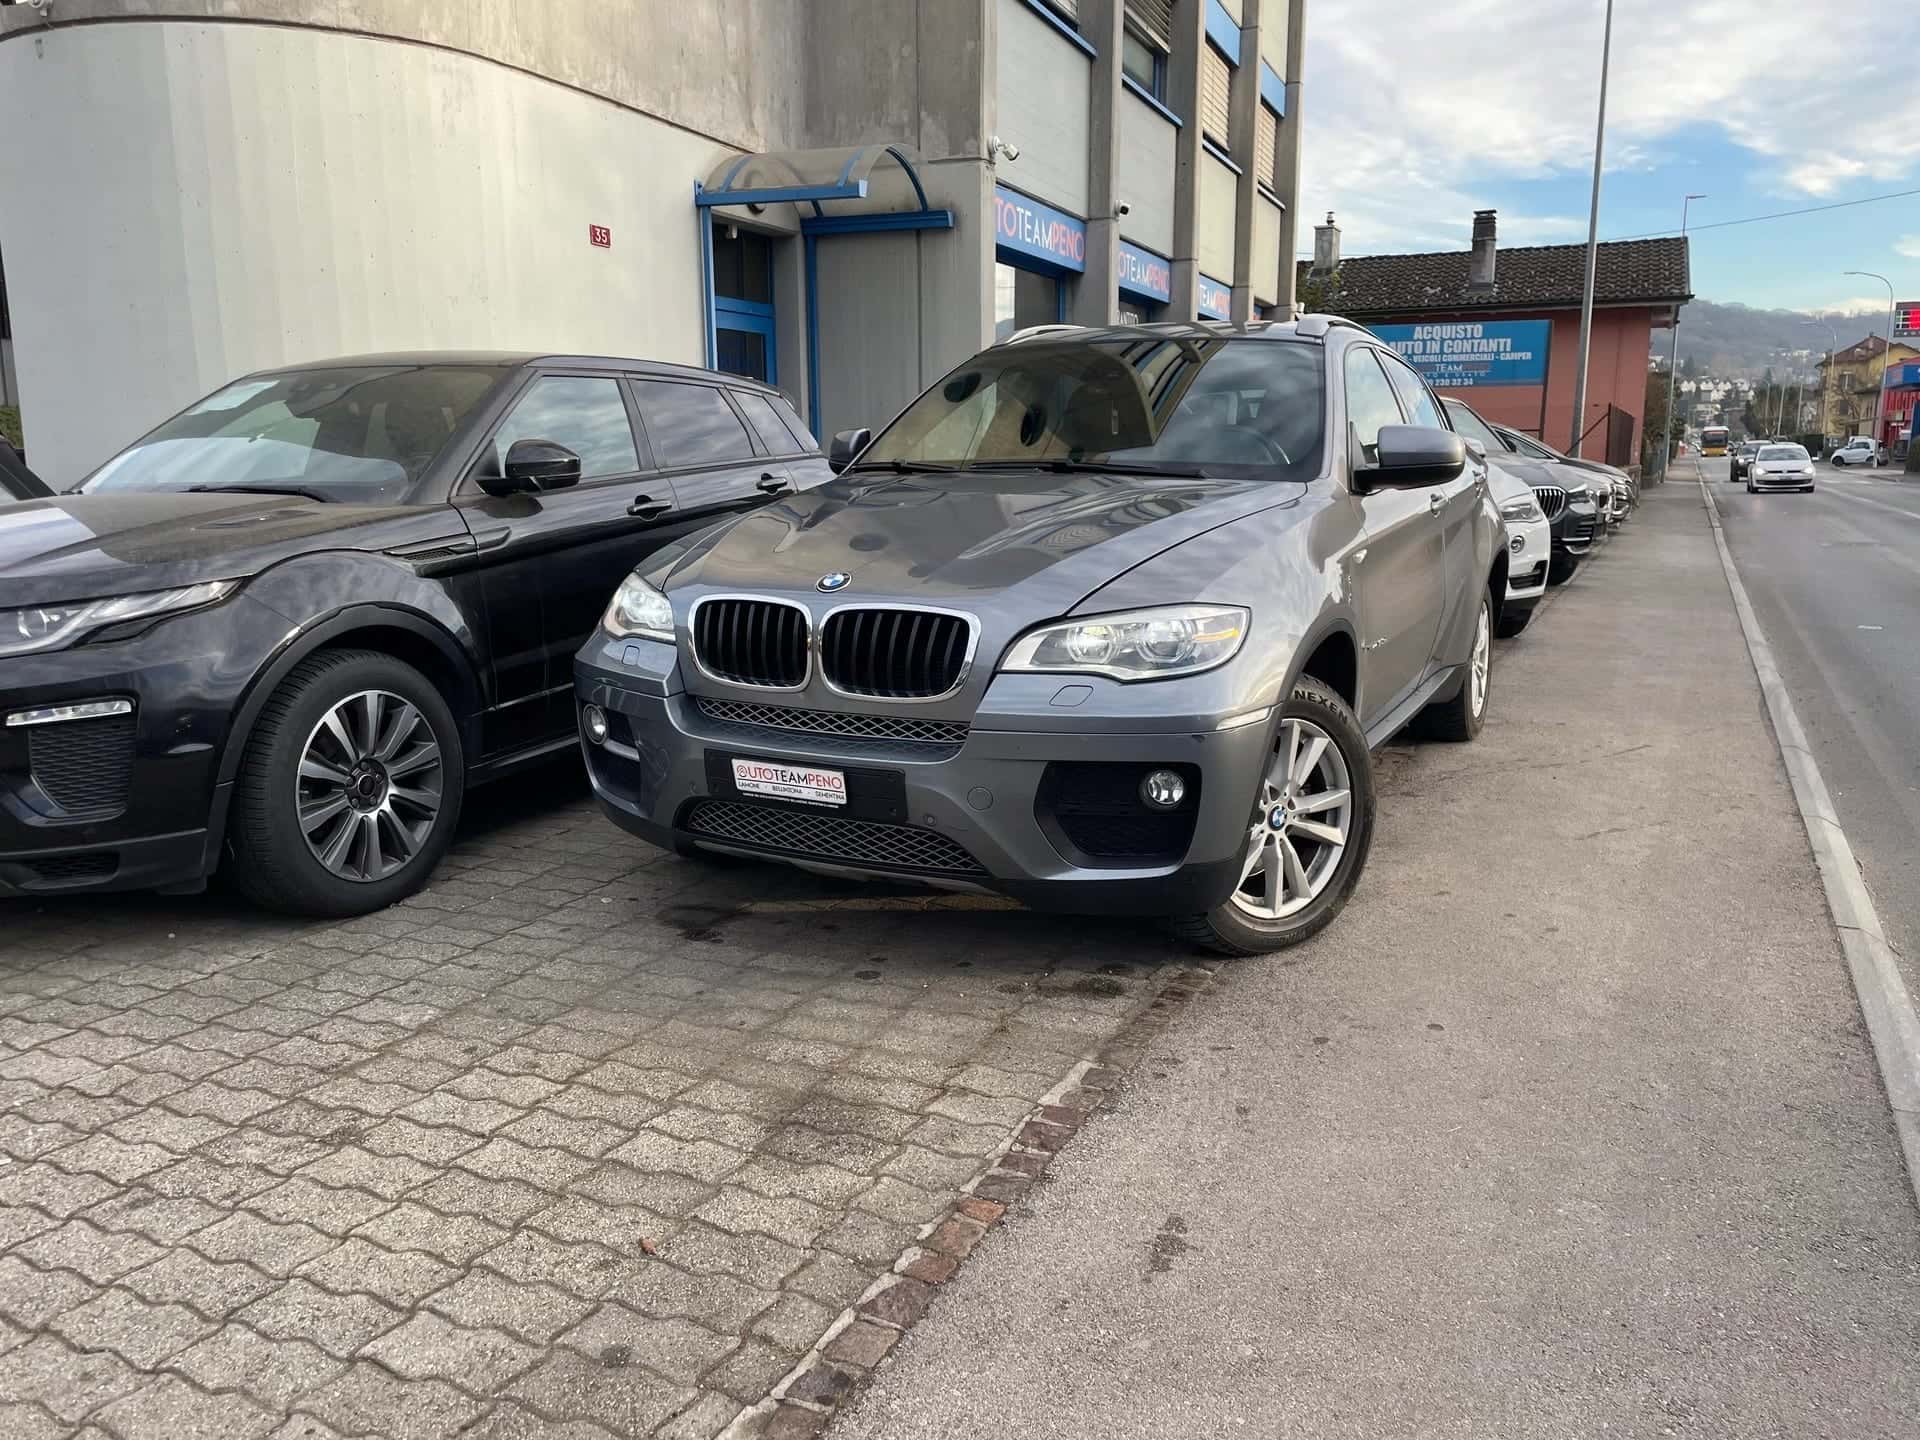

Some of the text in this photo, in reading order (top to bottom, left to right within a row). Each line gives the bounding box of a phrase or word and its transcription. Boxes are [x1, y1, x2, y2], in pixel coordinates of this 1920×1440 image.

[595, 228, 607, 243] 35
[1413, 324, 1483, 340] ACQUISTO
[1425, 340, 1440, 354] IN
[1444, 338, 1512, 353] CONTANTI
[1413, 354, 1441, 363] VEICOLI
[1442, 353, 1494, 362] COMMERCIALI
[1500, 352, 1532, 360] CAMPER
[1435, 363, 1463, 372] TEAM
[1294, 689, 1347, 724] NEXEN
